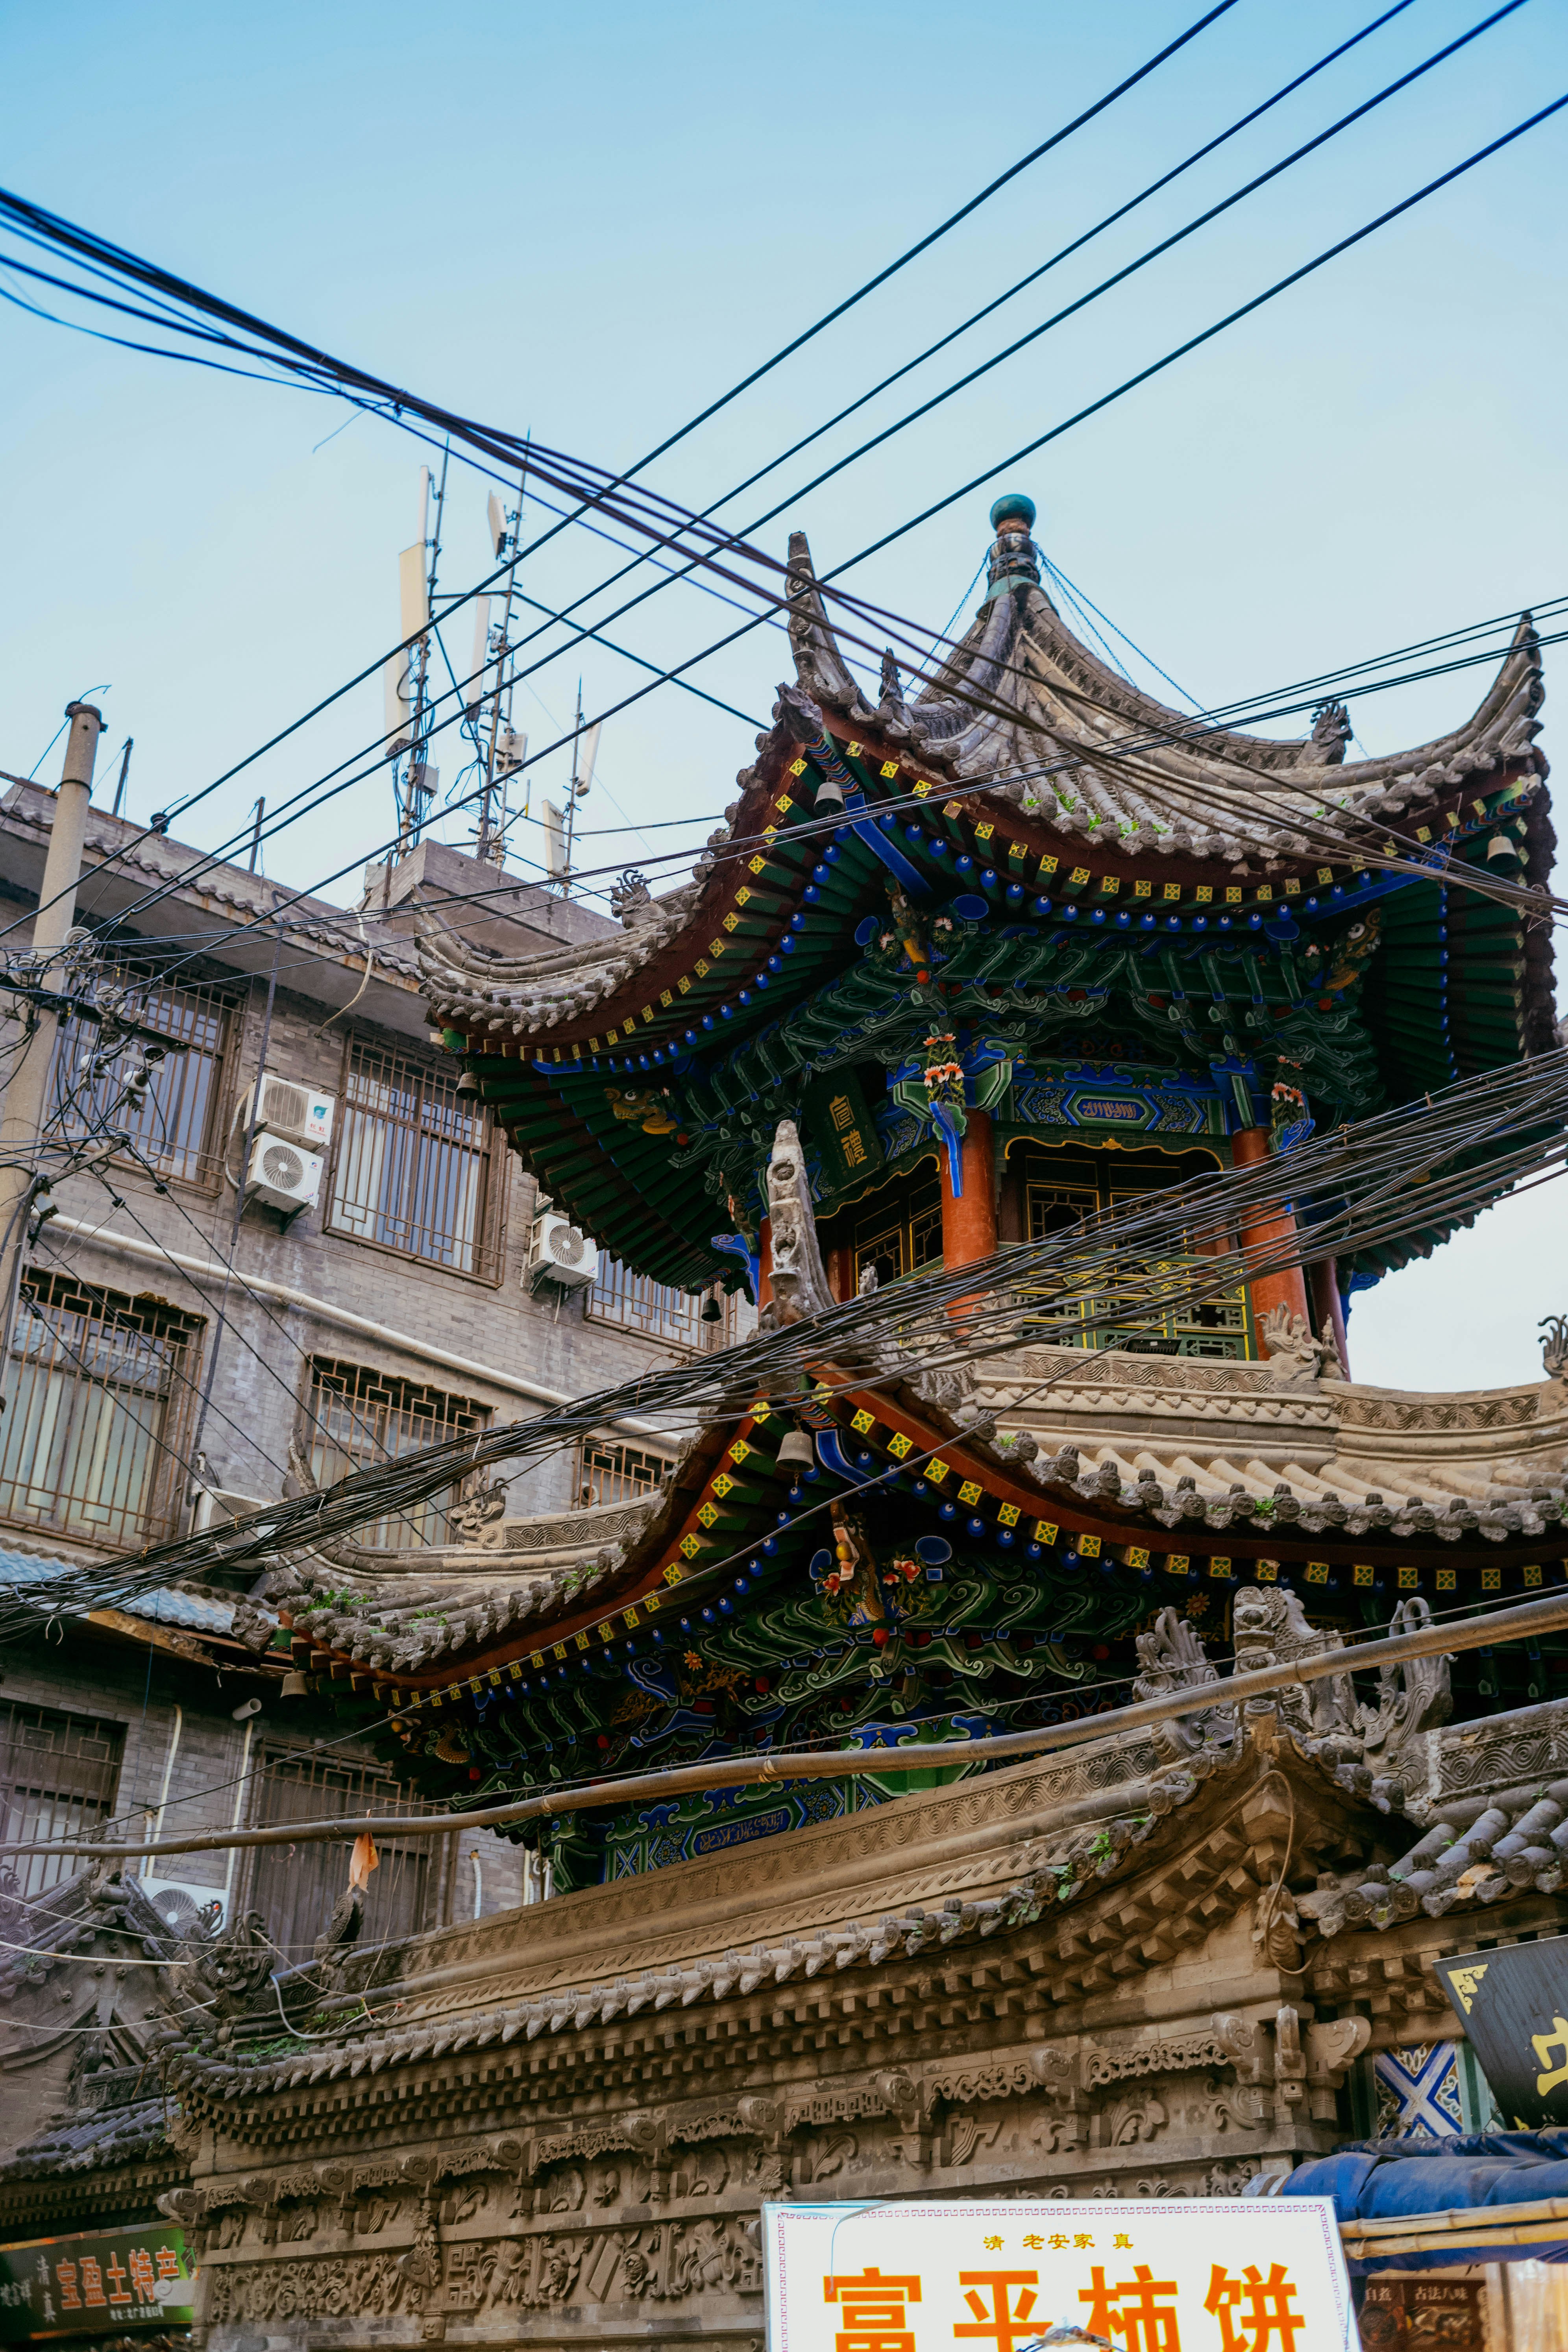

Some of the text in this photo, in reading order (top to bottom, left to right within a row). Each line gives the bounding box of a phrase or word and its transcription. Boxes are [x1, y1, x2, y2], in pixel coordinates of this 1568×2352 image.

[984, 2233, 1134, 2250] 清 老安家 真
[56, 2245, 179, 2309] 宝盈土特产
[823, 2263, 1305, 2352] 富平柿饼
